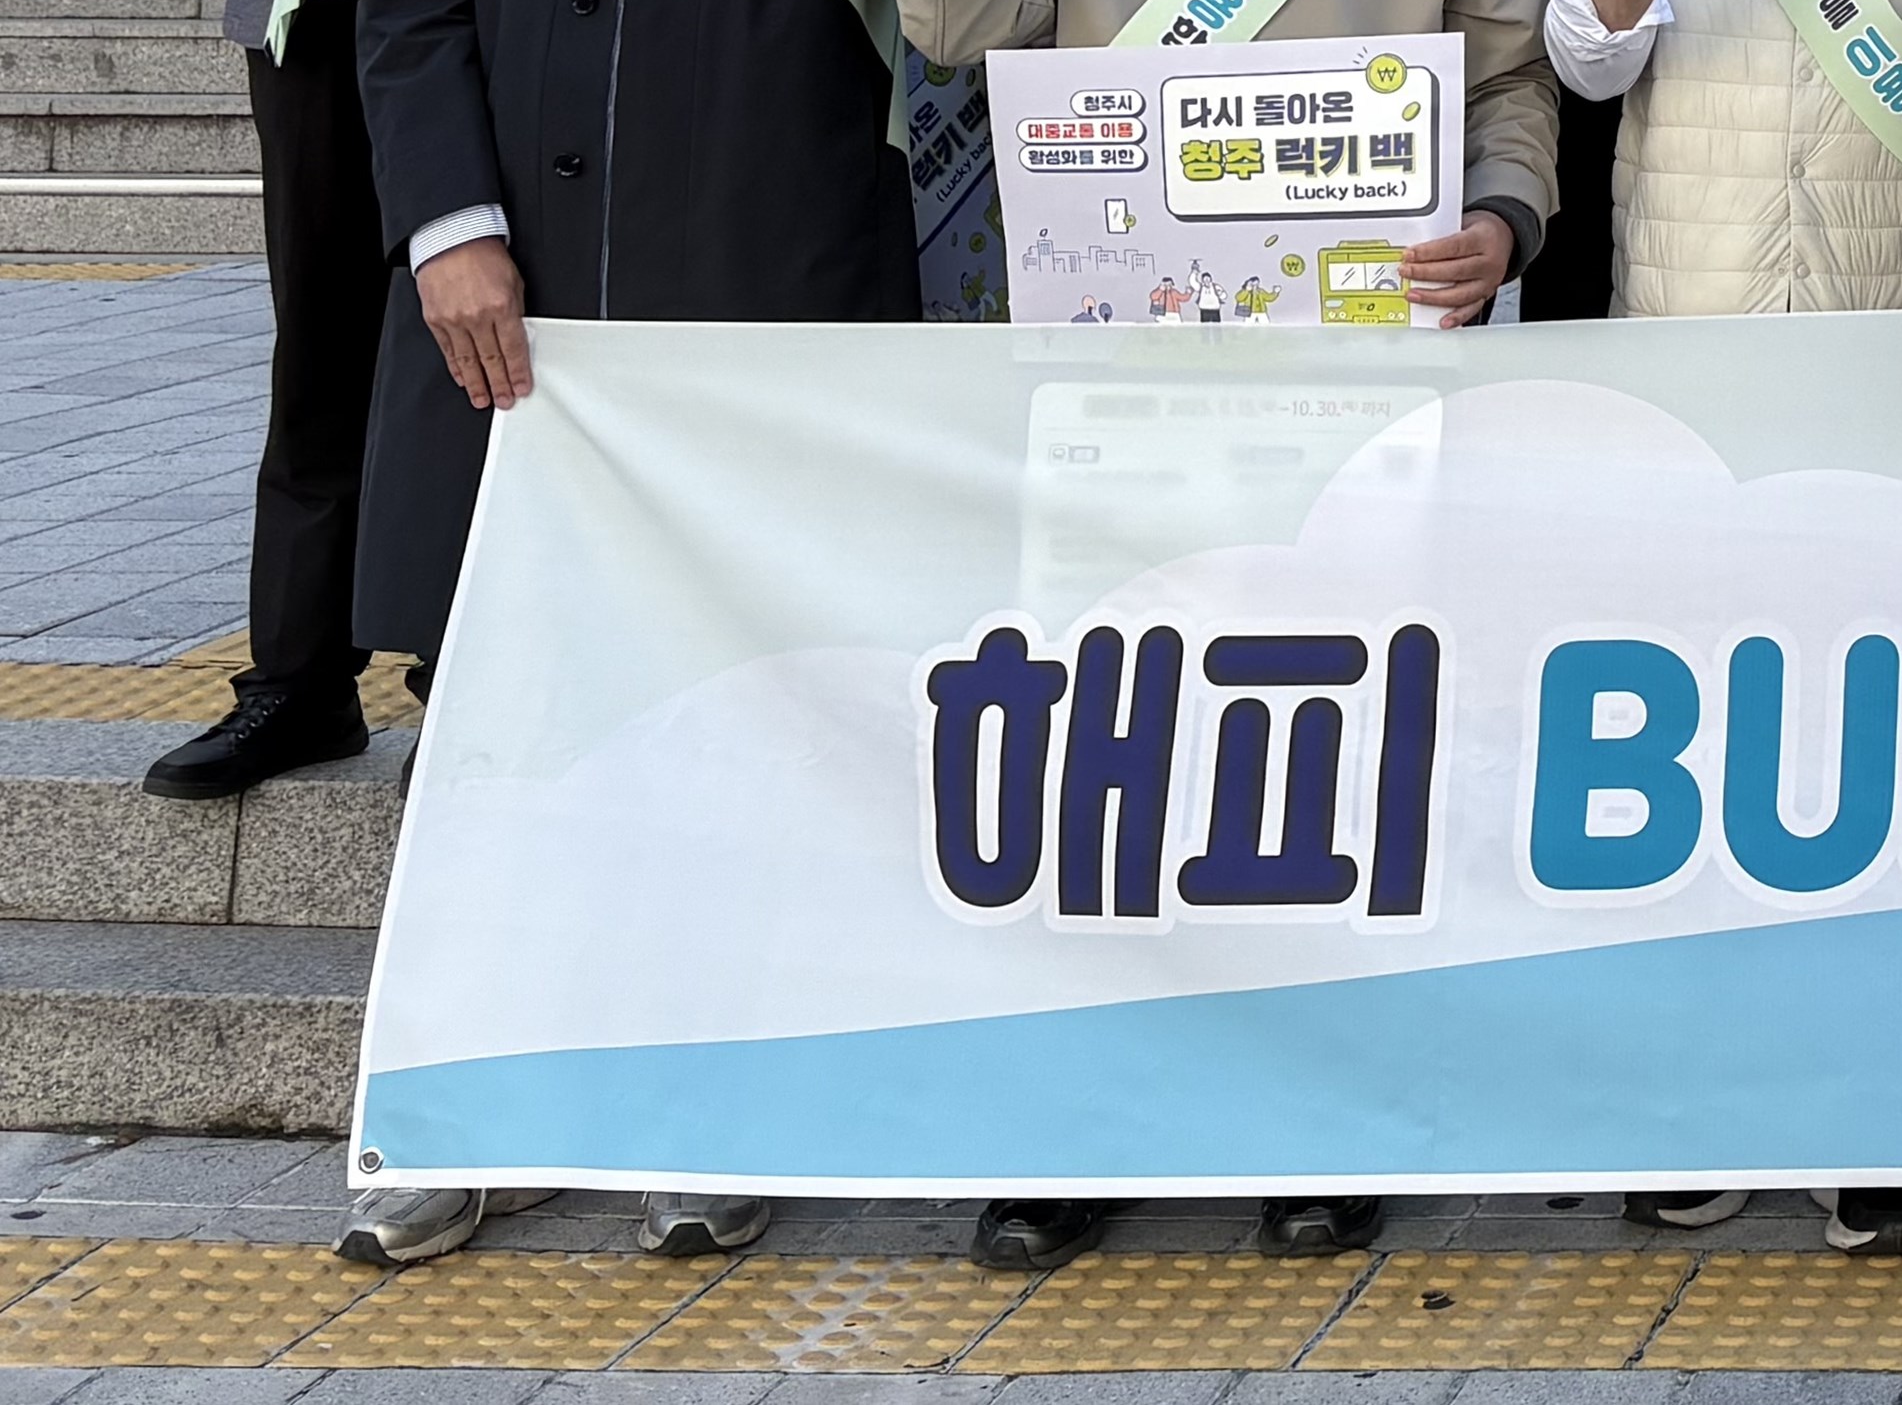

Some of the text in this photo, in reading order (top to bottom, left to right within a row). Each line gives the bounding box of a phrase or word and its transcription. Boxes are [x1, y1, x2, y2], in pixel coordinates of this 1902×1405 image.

[1084, 95, 1133, 111] 청주시
[1179, 91, 1354, 129] 다시 돌아온
[1101, 150, 1134, 164] 위한
[1179, 133, 1415, 181] 청주 럭키 백
[1285, 180, 1407, 202] (Lucky back)
[924, 618, 1444, 920] 해피
